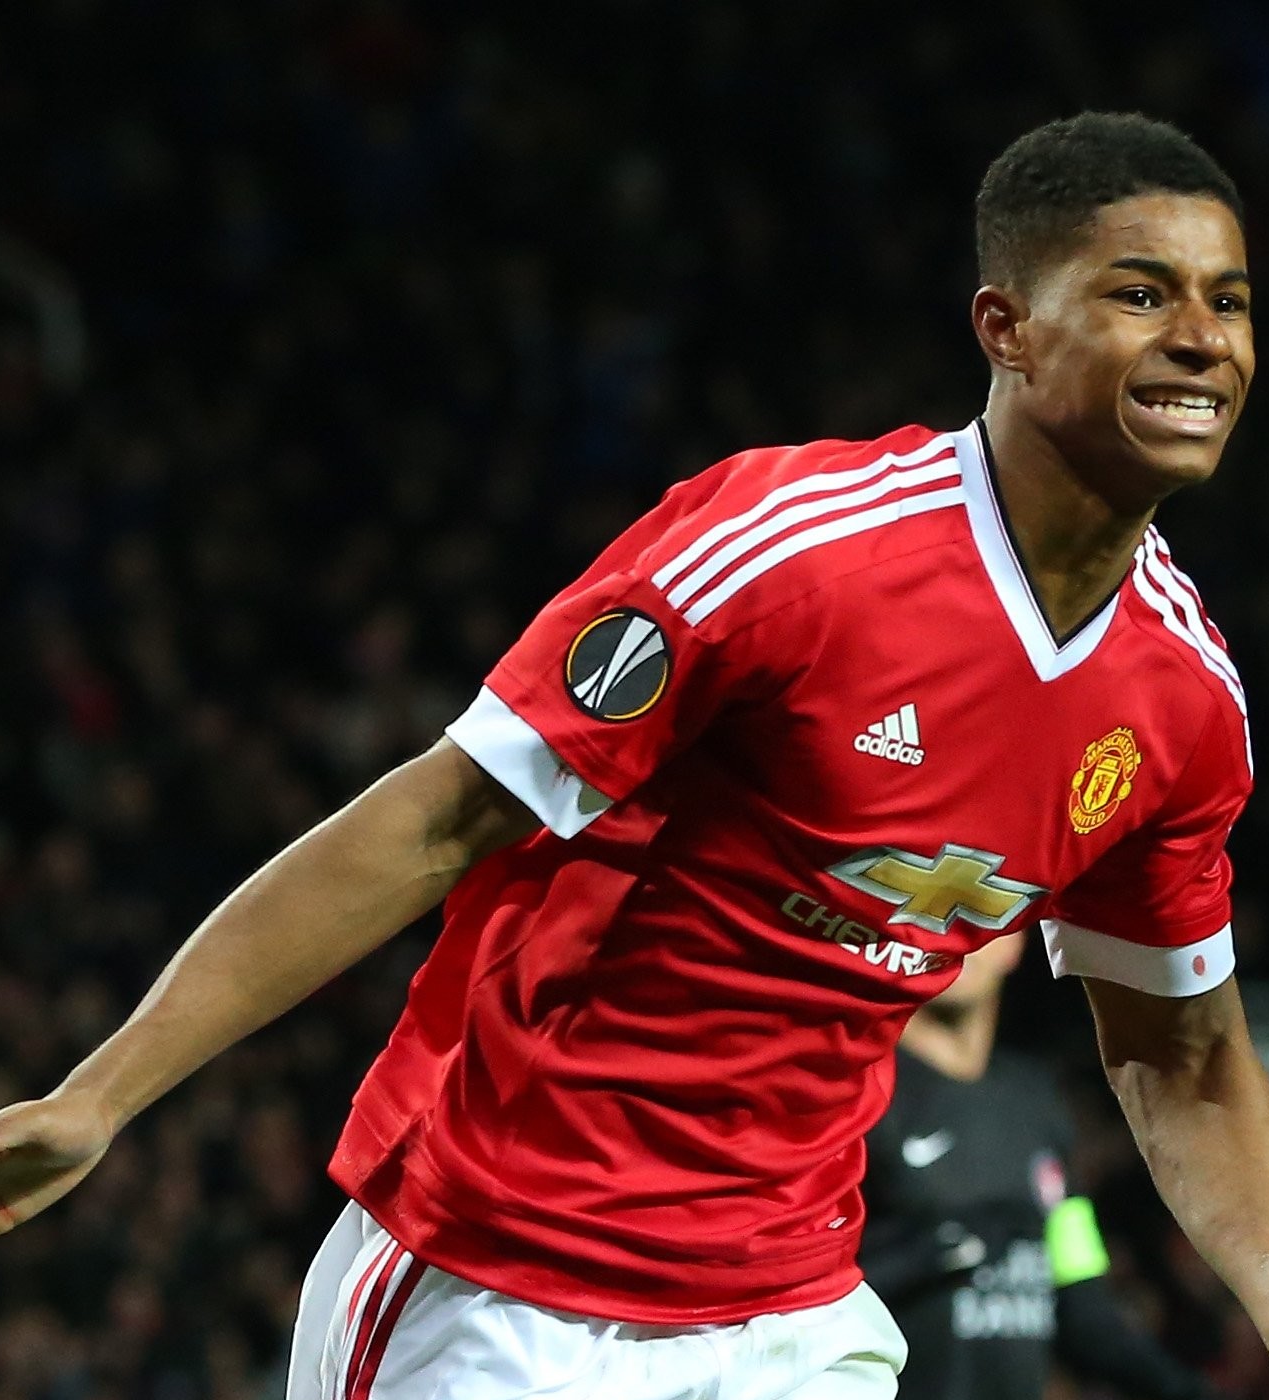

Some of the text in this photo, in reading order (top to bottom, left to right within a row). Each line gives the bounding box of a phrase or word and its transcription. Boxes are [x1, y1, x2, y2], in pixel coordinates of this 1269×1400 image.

[853, 733, 925, 766] adidas
[1086, 734, 1135, 773] MANCHESTER
[1072, 805, 1106, 827] UNITED
